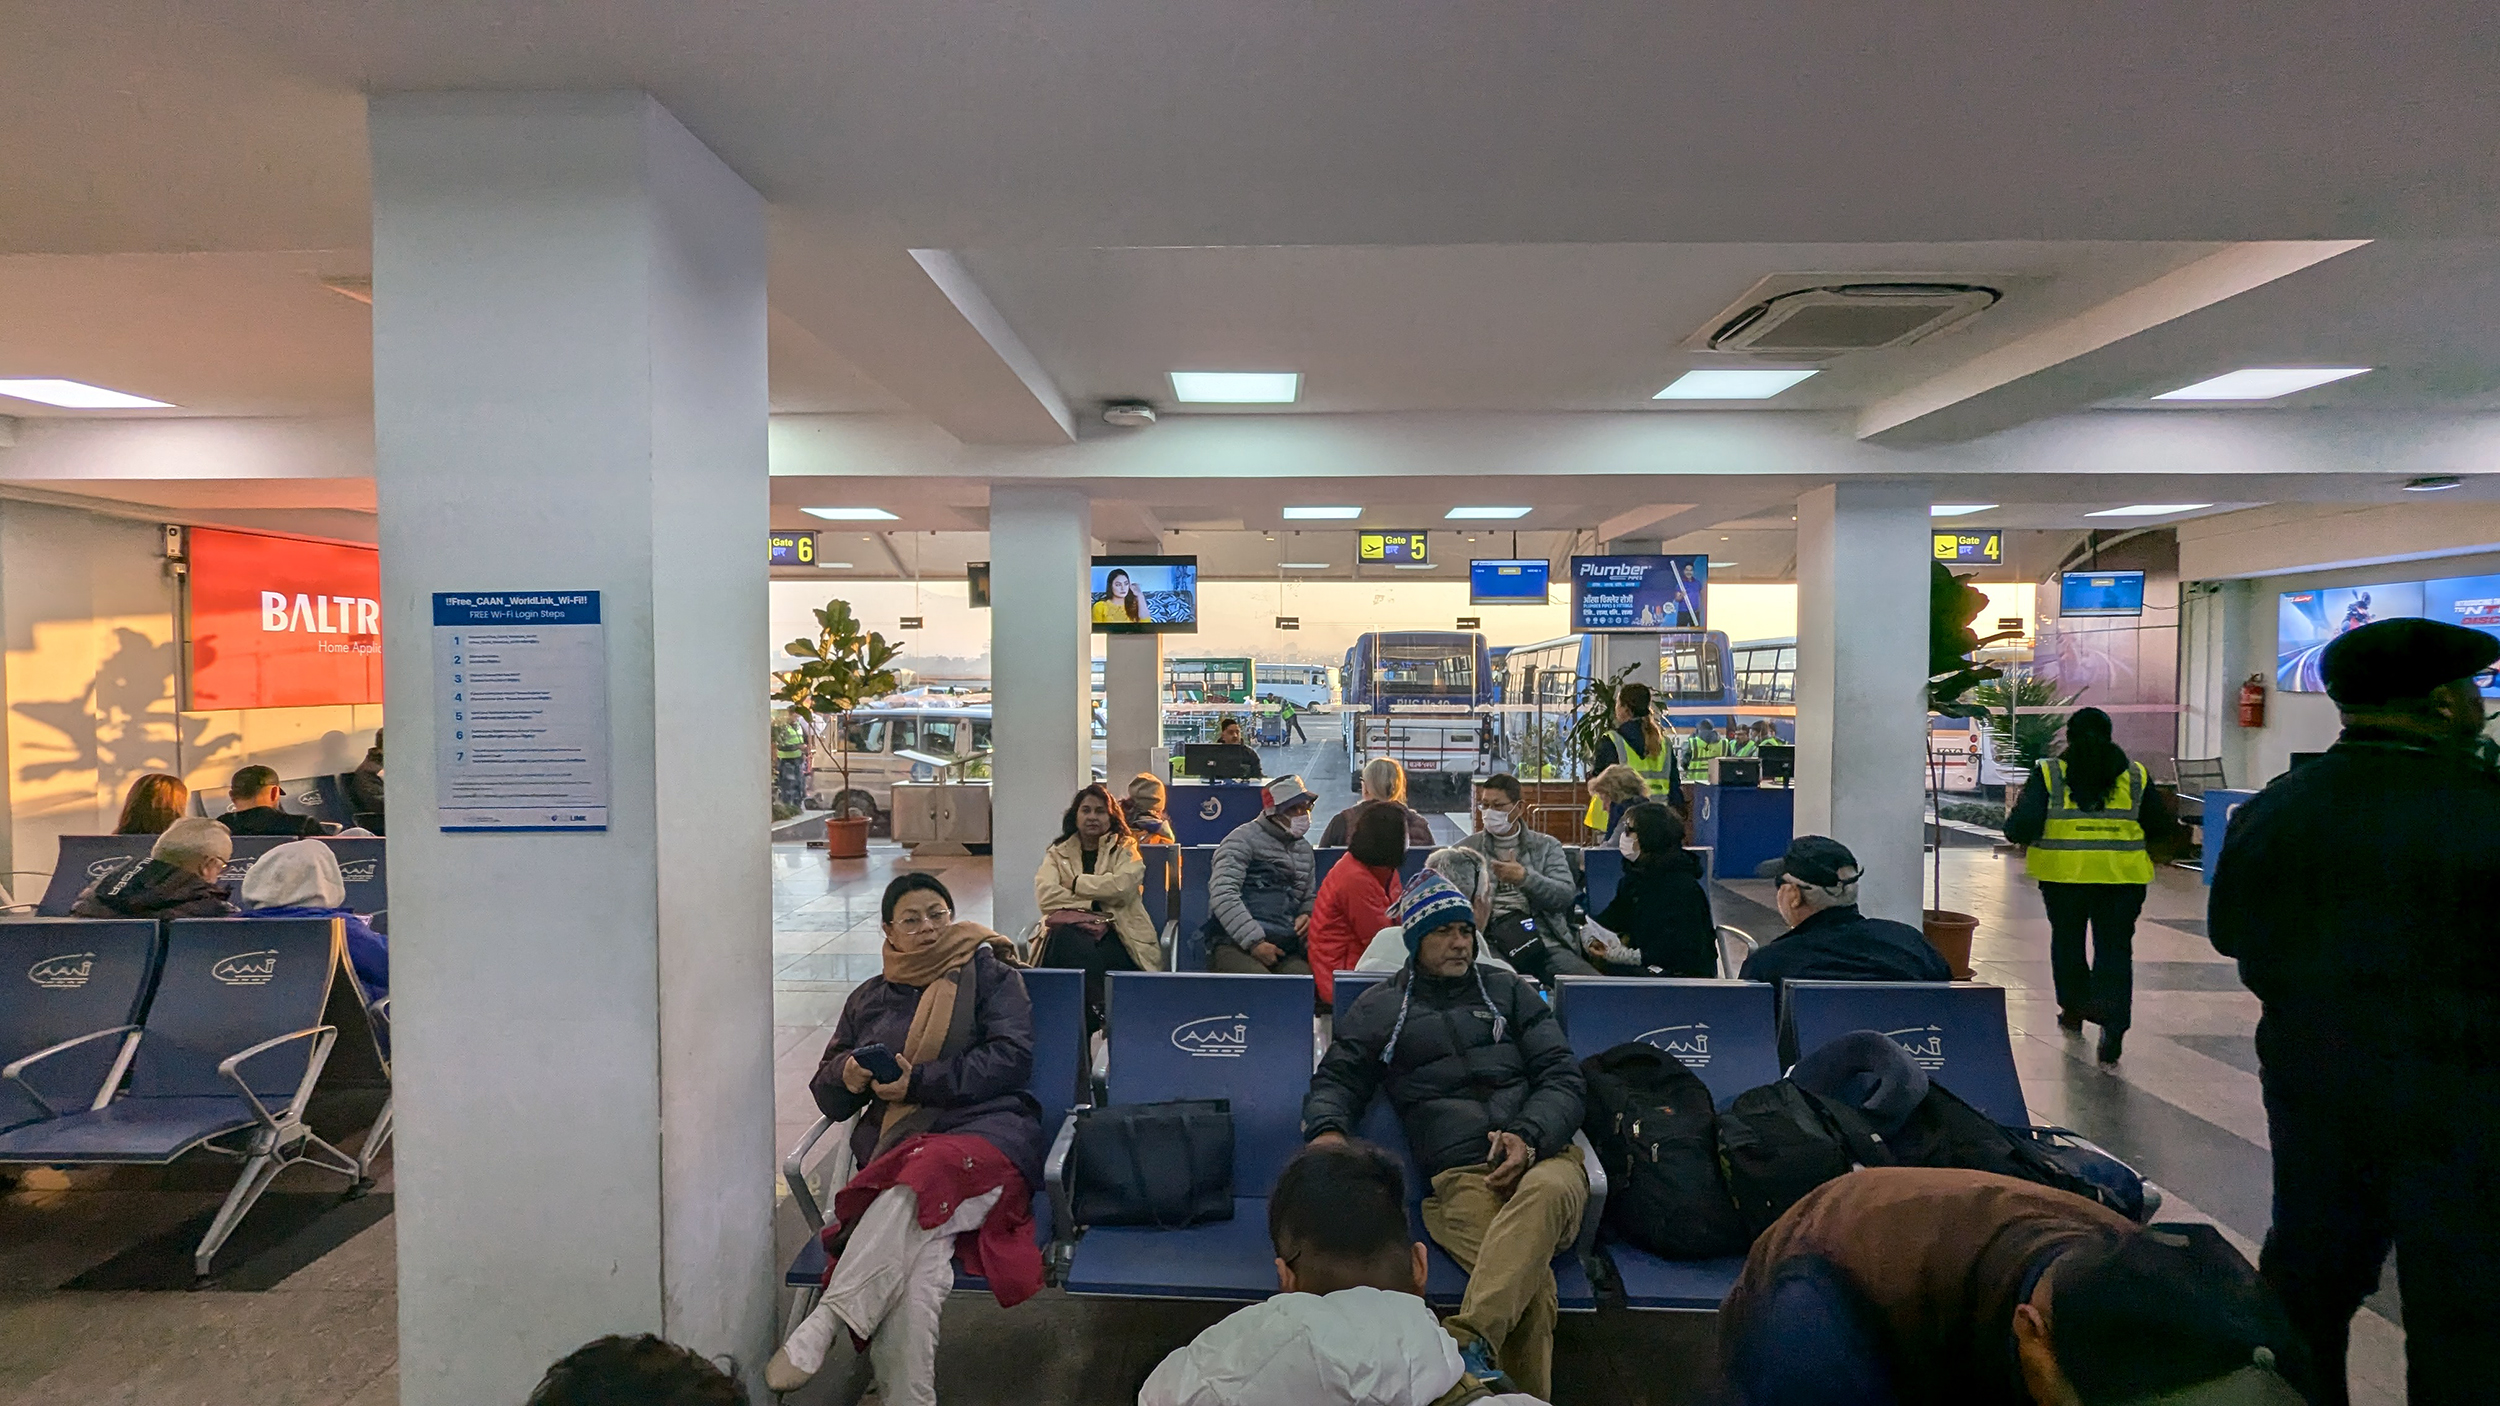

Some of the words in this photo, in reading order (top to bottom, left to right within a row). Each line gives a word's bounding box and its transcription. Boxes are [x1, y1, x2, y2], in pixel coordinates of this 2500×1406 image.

[772, 537, 794, 547] Gate
[798, 537, 813, 562] 6
[1385, 536, 1407, 545] Gate
[1410, 535, 1426, 560] 5
[1958, 536, 1980, 545] Gate
[1983, 535, 1999, 560] 4
[1579, 563, 1648, 576] Plumber
[261, 590, 380, 635] BALTR
[469, 611, 489, 619] FREE
[491, 610, 514, 618] Wi-Fi
[515, 610, 539, 620] Login
[540, 610, 566, 620] Steps
[2464, 605, 2500, 615] NT
[454, 636, 460, 645] 1
[318, 640, 349, 654] Home
[454, 656, 461, 665] 2
[454, 674, 462, 683] 3
[454, 693, 462, 702] 4
[455, 712, 463, 721] 5
[456, 731, 463, 740] 6
[456, 752, 464, 761] 7
